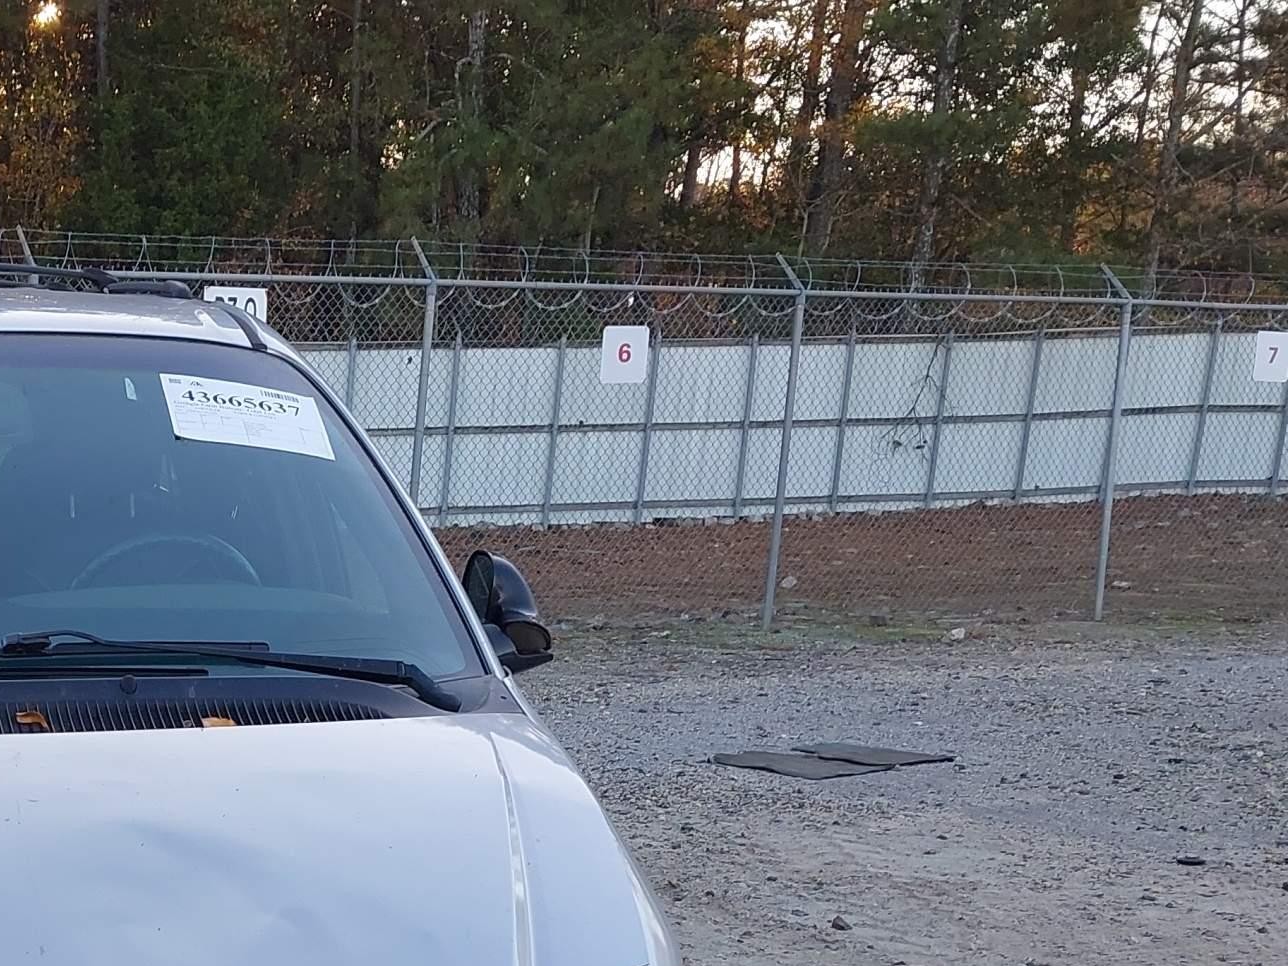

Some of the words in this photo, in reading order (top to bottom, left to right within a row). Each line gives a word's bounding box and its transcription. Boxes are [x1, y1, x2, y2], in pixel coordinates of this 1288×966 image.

[617, 343, 632, 363] 6
[1268, 346, 1279, 364] 7
[182, 389, 300, 417] 43665637
